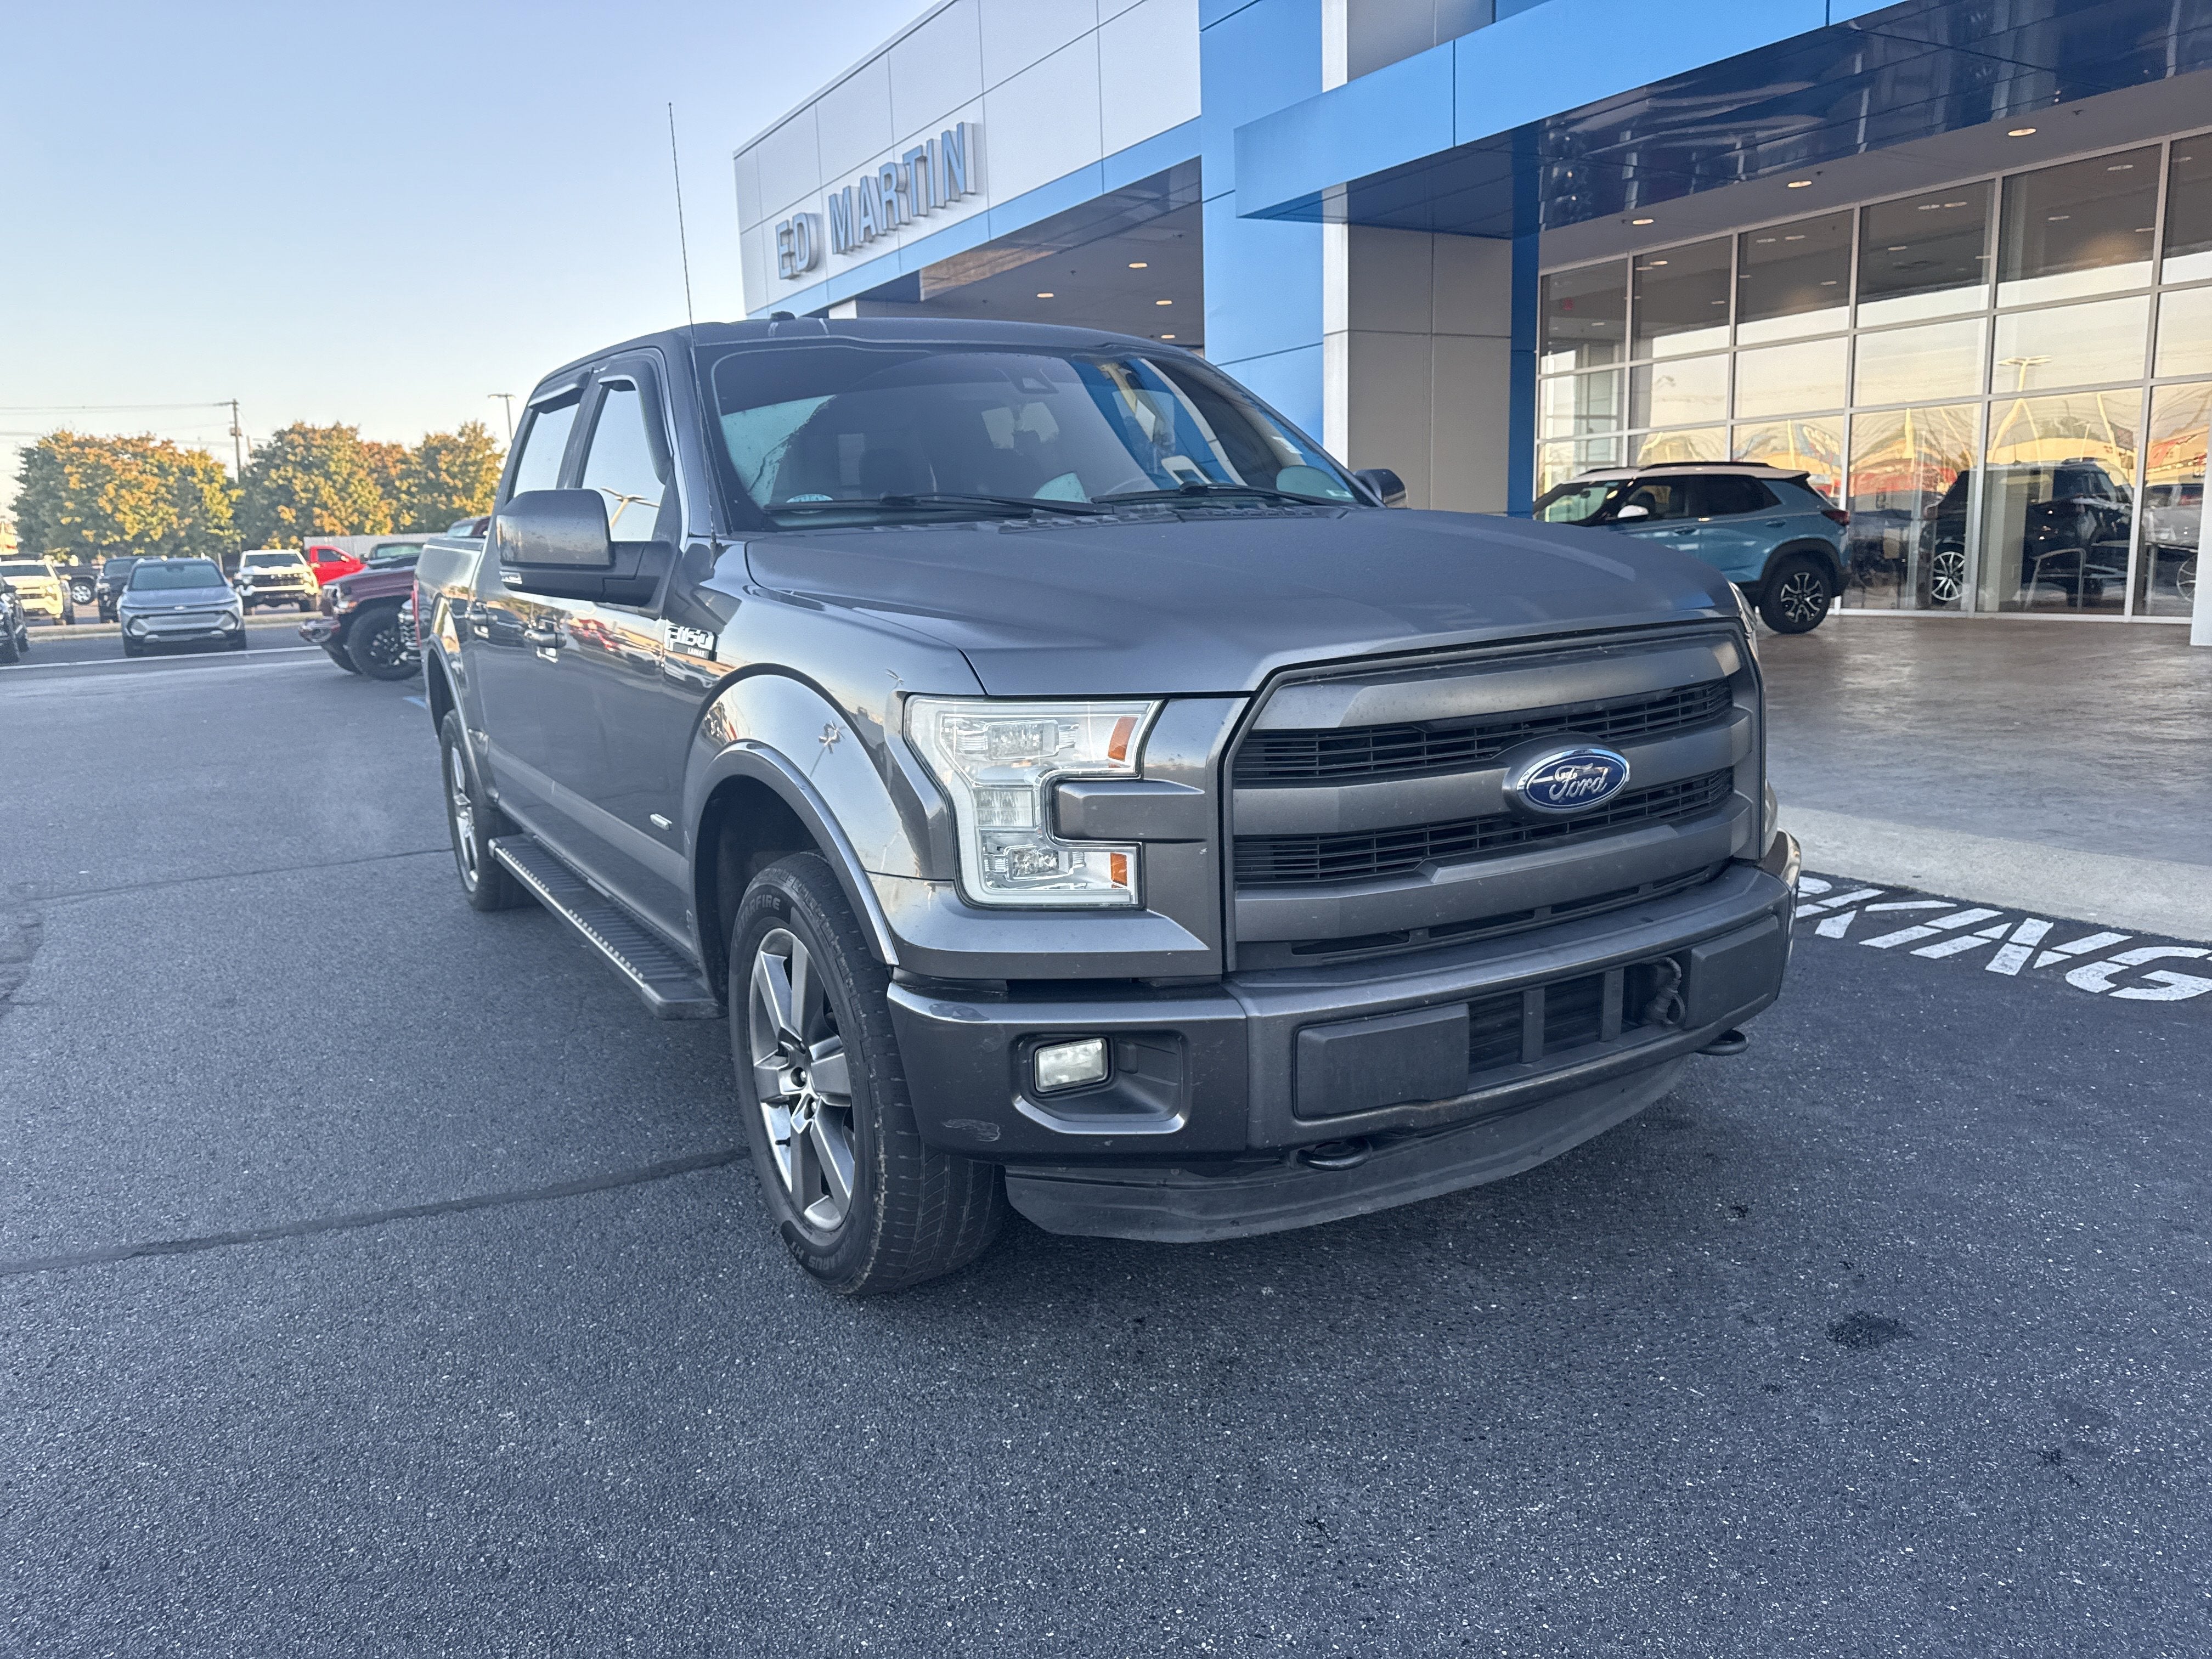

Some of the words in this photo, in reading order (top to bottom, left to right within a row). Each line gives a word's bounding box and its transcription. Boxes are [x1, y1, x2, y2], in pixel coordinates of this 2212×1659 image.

[775, 212, 821, 279] ED
[828, 122, 976, 255] MARTIN
[1549, 763, 1609, 800] Ford
